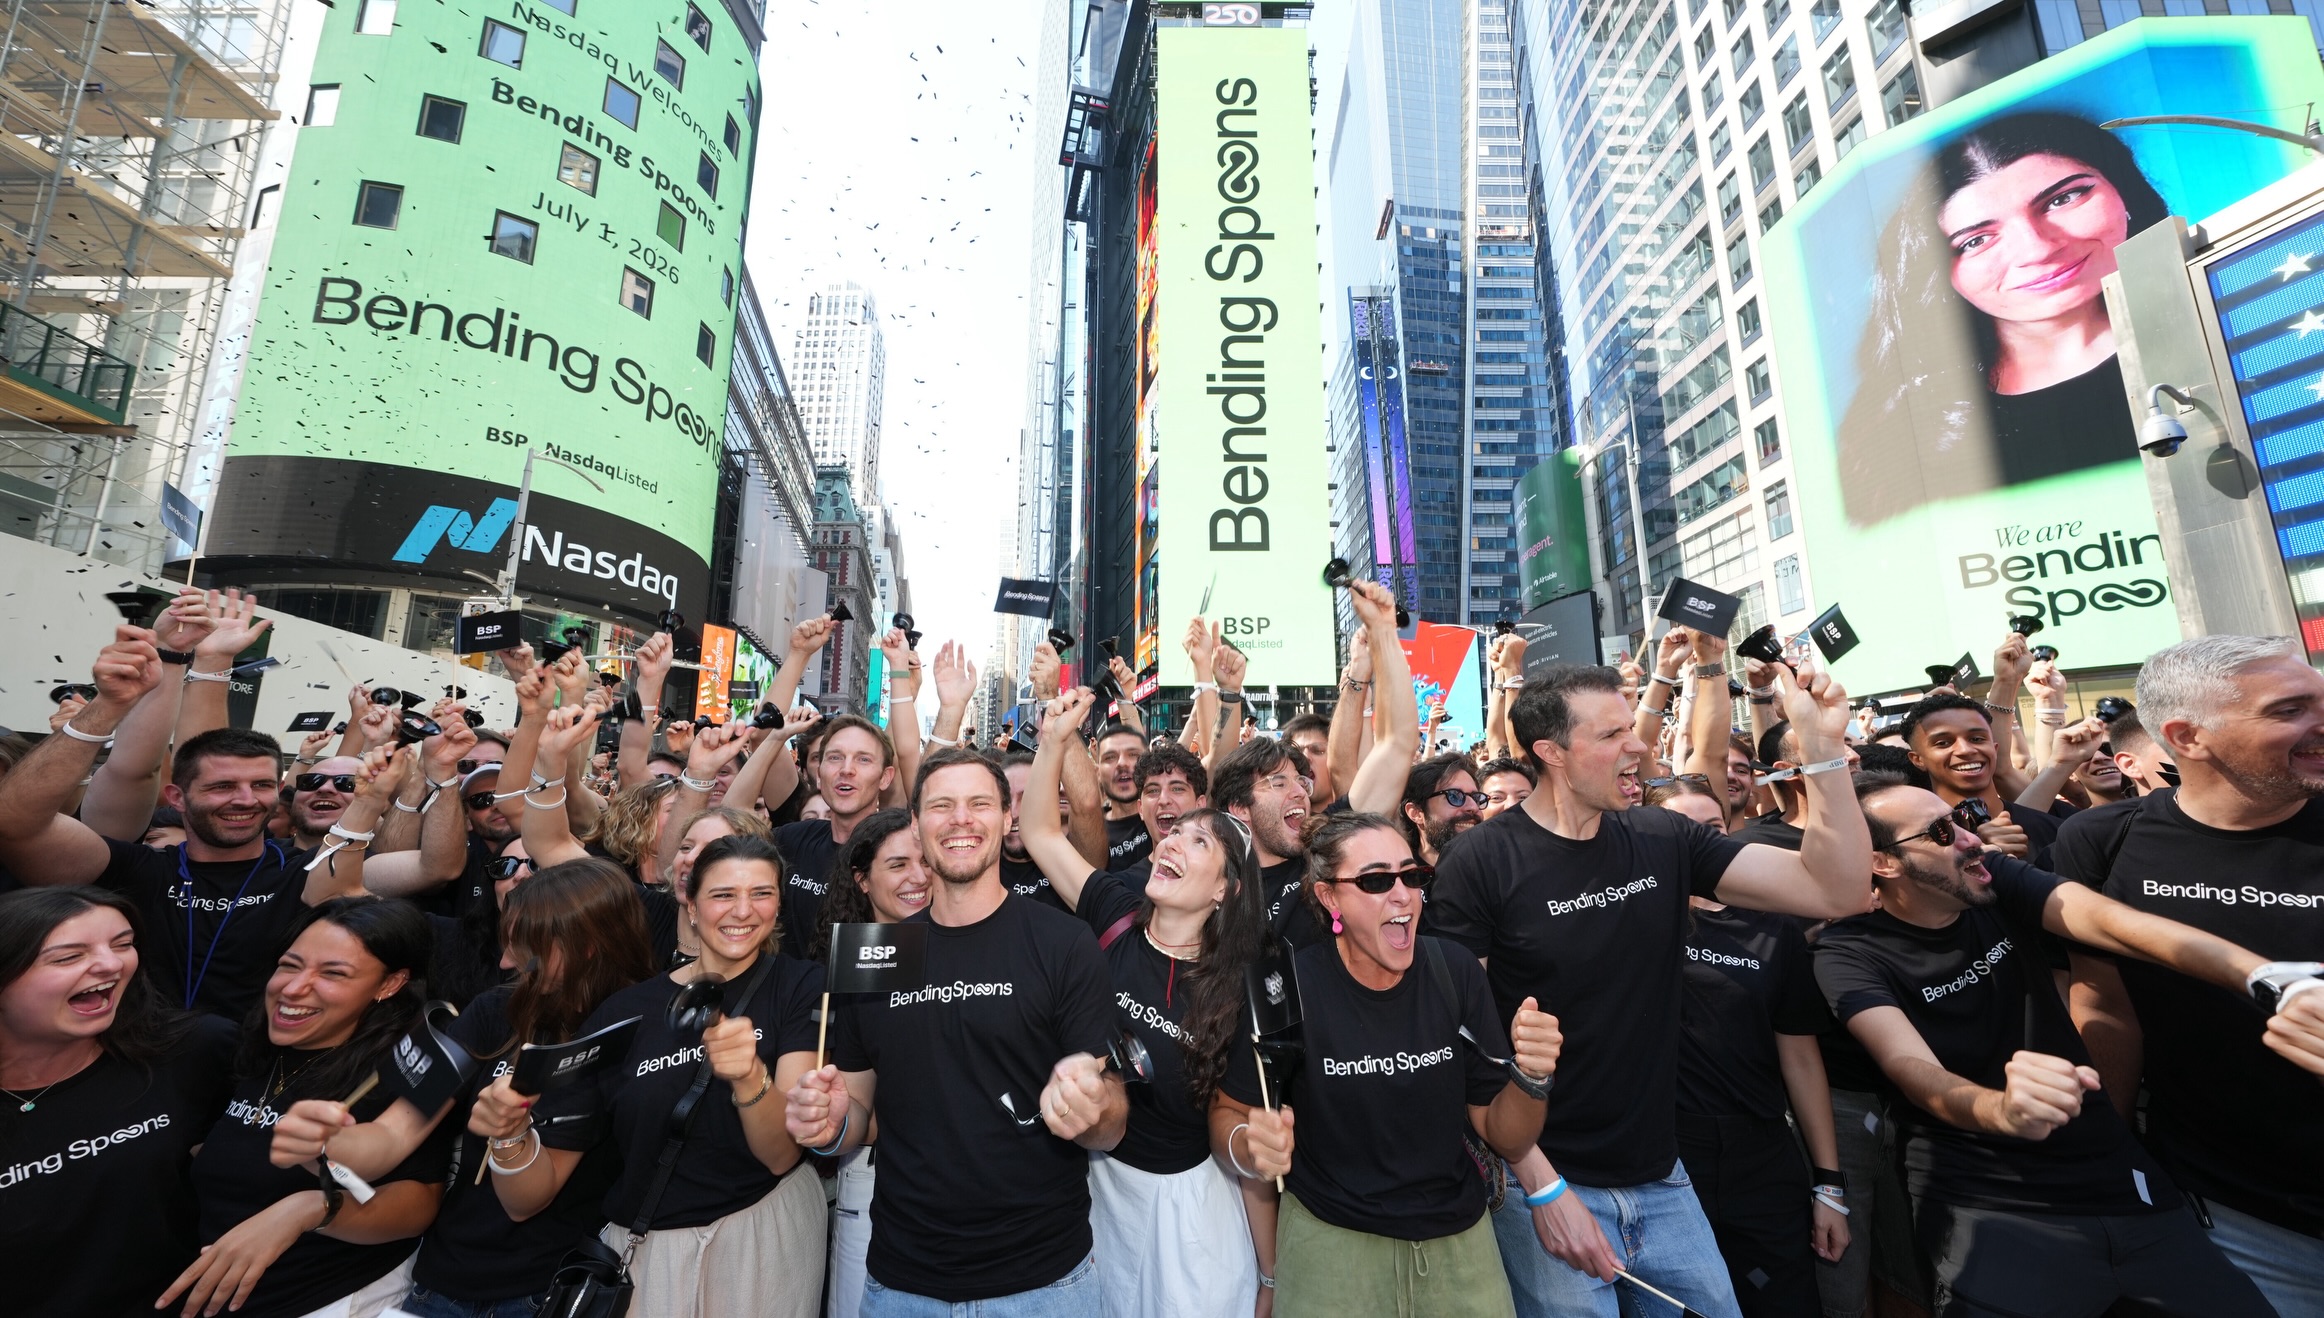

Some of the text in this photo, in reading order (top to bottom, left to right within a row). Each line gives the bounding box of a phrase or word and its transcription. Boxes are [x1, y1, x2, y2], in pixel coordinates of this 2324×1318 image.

[512, 1, 722, 162] Nasdaq Welcomes
[491, 80, 715, 236] Bending Spoons
[532, 192, 679, 284] July 1, 2026
[1205, 78, 1278, 551] Bending Spoons
[312, 276, 722, 469] Bending Spoons
[486, 427, 528, 447] BSP
[545, 442, 658, 494] NasdaqListed
[1995, 520, 2082, 549] We are
[522, 524, 678, 609] Nasdaq
[1958, 530, 2165, 589] Bendin
[1686, 596, 1716, 611] BSP
[2004, 575, 2174, 627] Spoo
[477, 624, 502, 636] BSP
[1223, 617, 1270, 634] BSP
[1826, 621, 1841, 639] BSP
[229, 681, 254, 695] TORE
[1547, 876, 1658, 916] Bending Spoons
[2143, 880, 2324, 908] Bending Spoon
[858, 946, 896, 960] BSP
[1701, 948, 1760, 970] Spoons
[890, 981, 1012, 1008] Bending Spoons
[400, 1033, 433, 1075] BSP
[559, 1045, 600, 1070] BSP
[1323, 1046, 1453, 1076] Bending Spoons
[0, 1113, 170, 1188] ding Spoons
